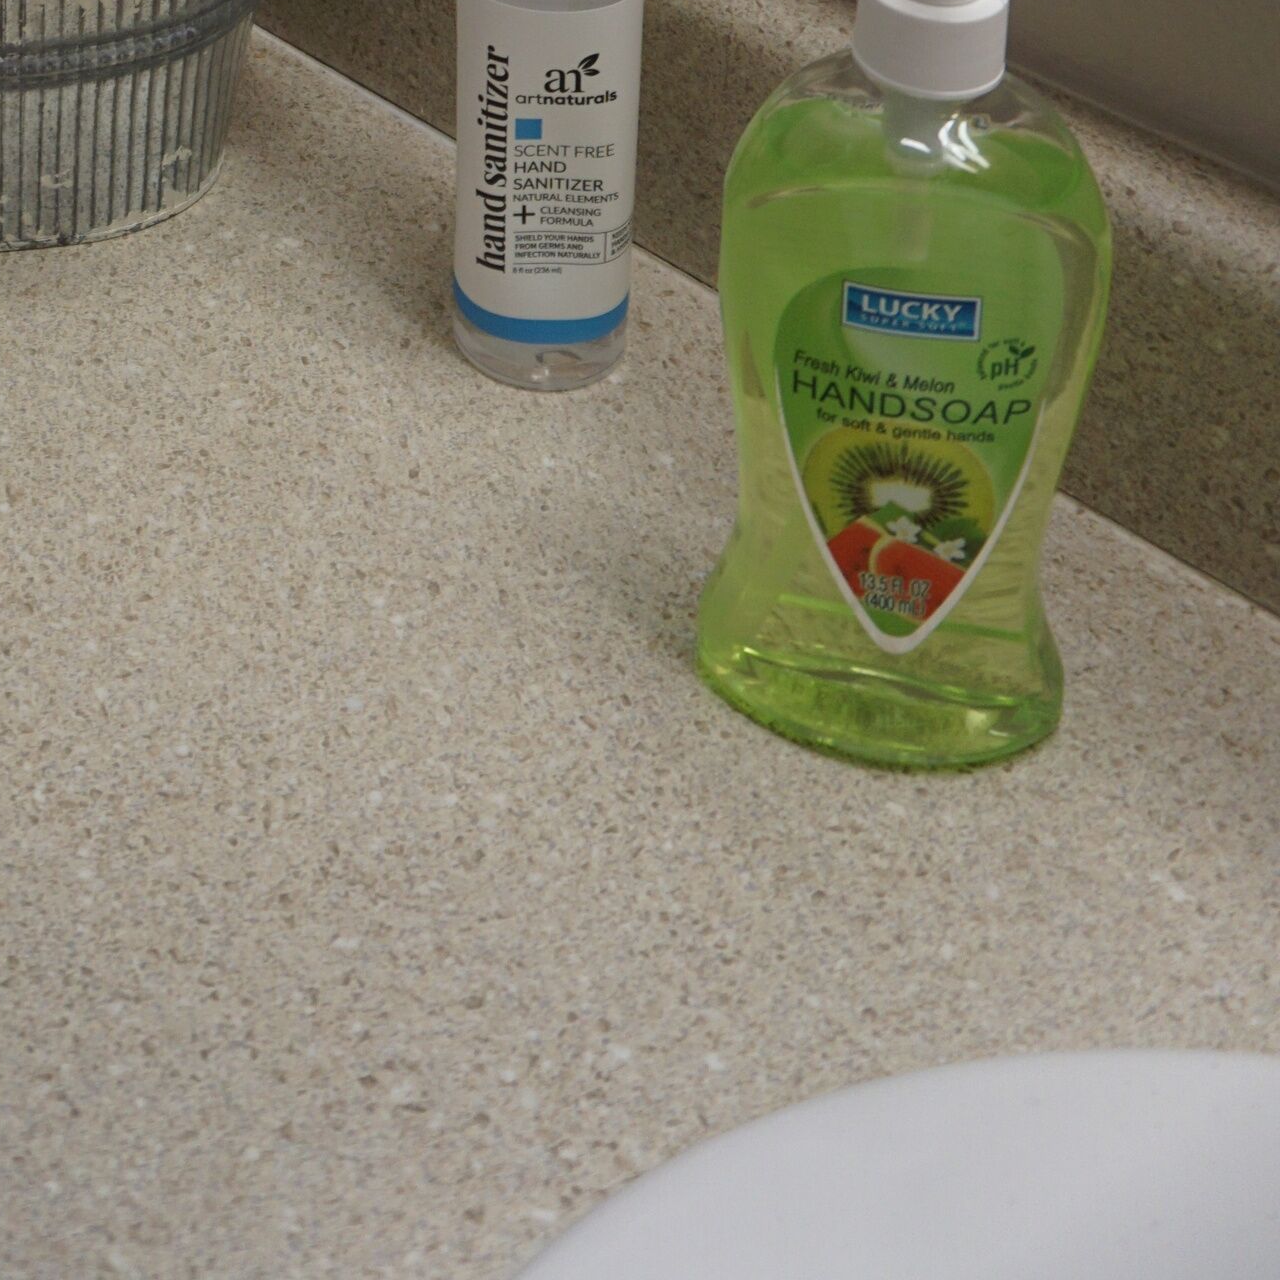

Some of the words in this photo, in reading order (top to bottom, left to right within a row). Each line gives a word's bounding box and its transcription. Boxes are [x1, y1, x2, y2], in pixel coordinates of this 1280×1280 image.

[515, 90, 617, 105] artnaturals
[477, 45, 509, 187] sanitizer
[514, 144, 570, 157] SCENT
[574, 143, 615, 158] FREE
[514, 161, 567, 173] HAND
[513, 178, 603, 192] SANITIZER
[513, 193, 562, 202] NATURAL
[565, 192, 619, 203] ELEMENTS
[540, 206, 601, 216] CLEANSING
[540, 216, 594, 227] FORMULA
[476, 189, 506, 273] hand
[515, 234, 542, 242] SHIELD
[545, 234, 565, 242] YOUR
[558, 251, 600, 259] NATURALLY
[861, 294, 962, 322] LUCKY
[793, 349, 839, 374] Fresh
[845, 364, 880, 386] Kiwi
[885, 373, 897, 389] &
[903, 375, 955, 394] Melon
[990, 358, 1019, 380] pH
[792, 369, 1032, 425] HANDSOAP
[817, 407, 838, 423] for
[842, 416, 872, 432] soft
[875, 422, 887, 435] &
[892, 425, 942, 441] gentle
[946, 430, 995, 443] hands
[865, 591, 894, 612] (400
